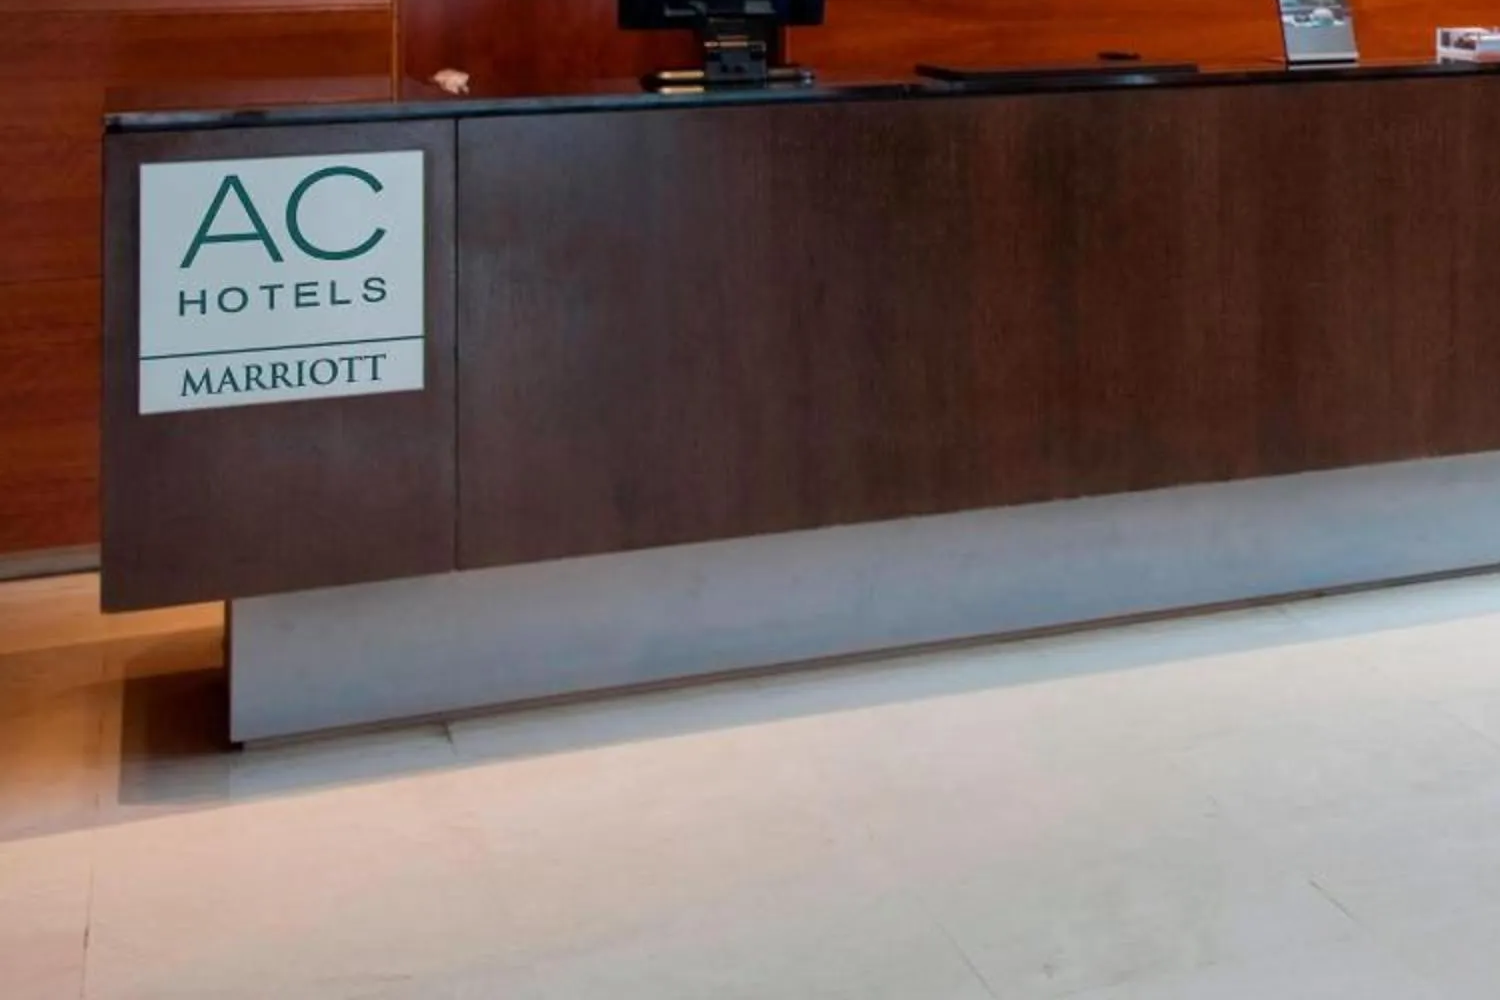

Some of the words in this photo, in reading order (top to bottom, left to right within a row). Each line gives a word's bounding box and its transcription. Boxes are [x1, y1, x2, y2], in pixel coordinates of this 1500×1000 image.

[180, 166, 386, 268] AC
[179, 277, 387, 316] HOTELS
[180, 354, 387, 397] MARRIOTT
